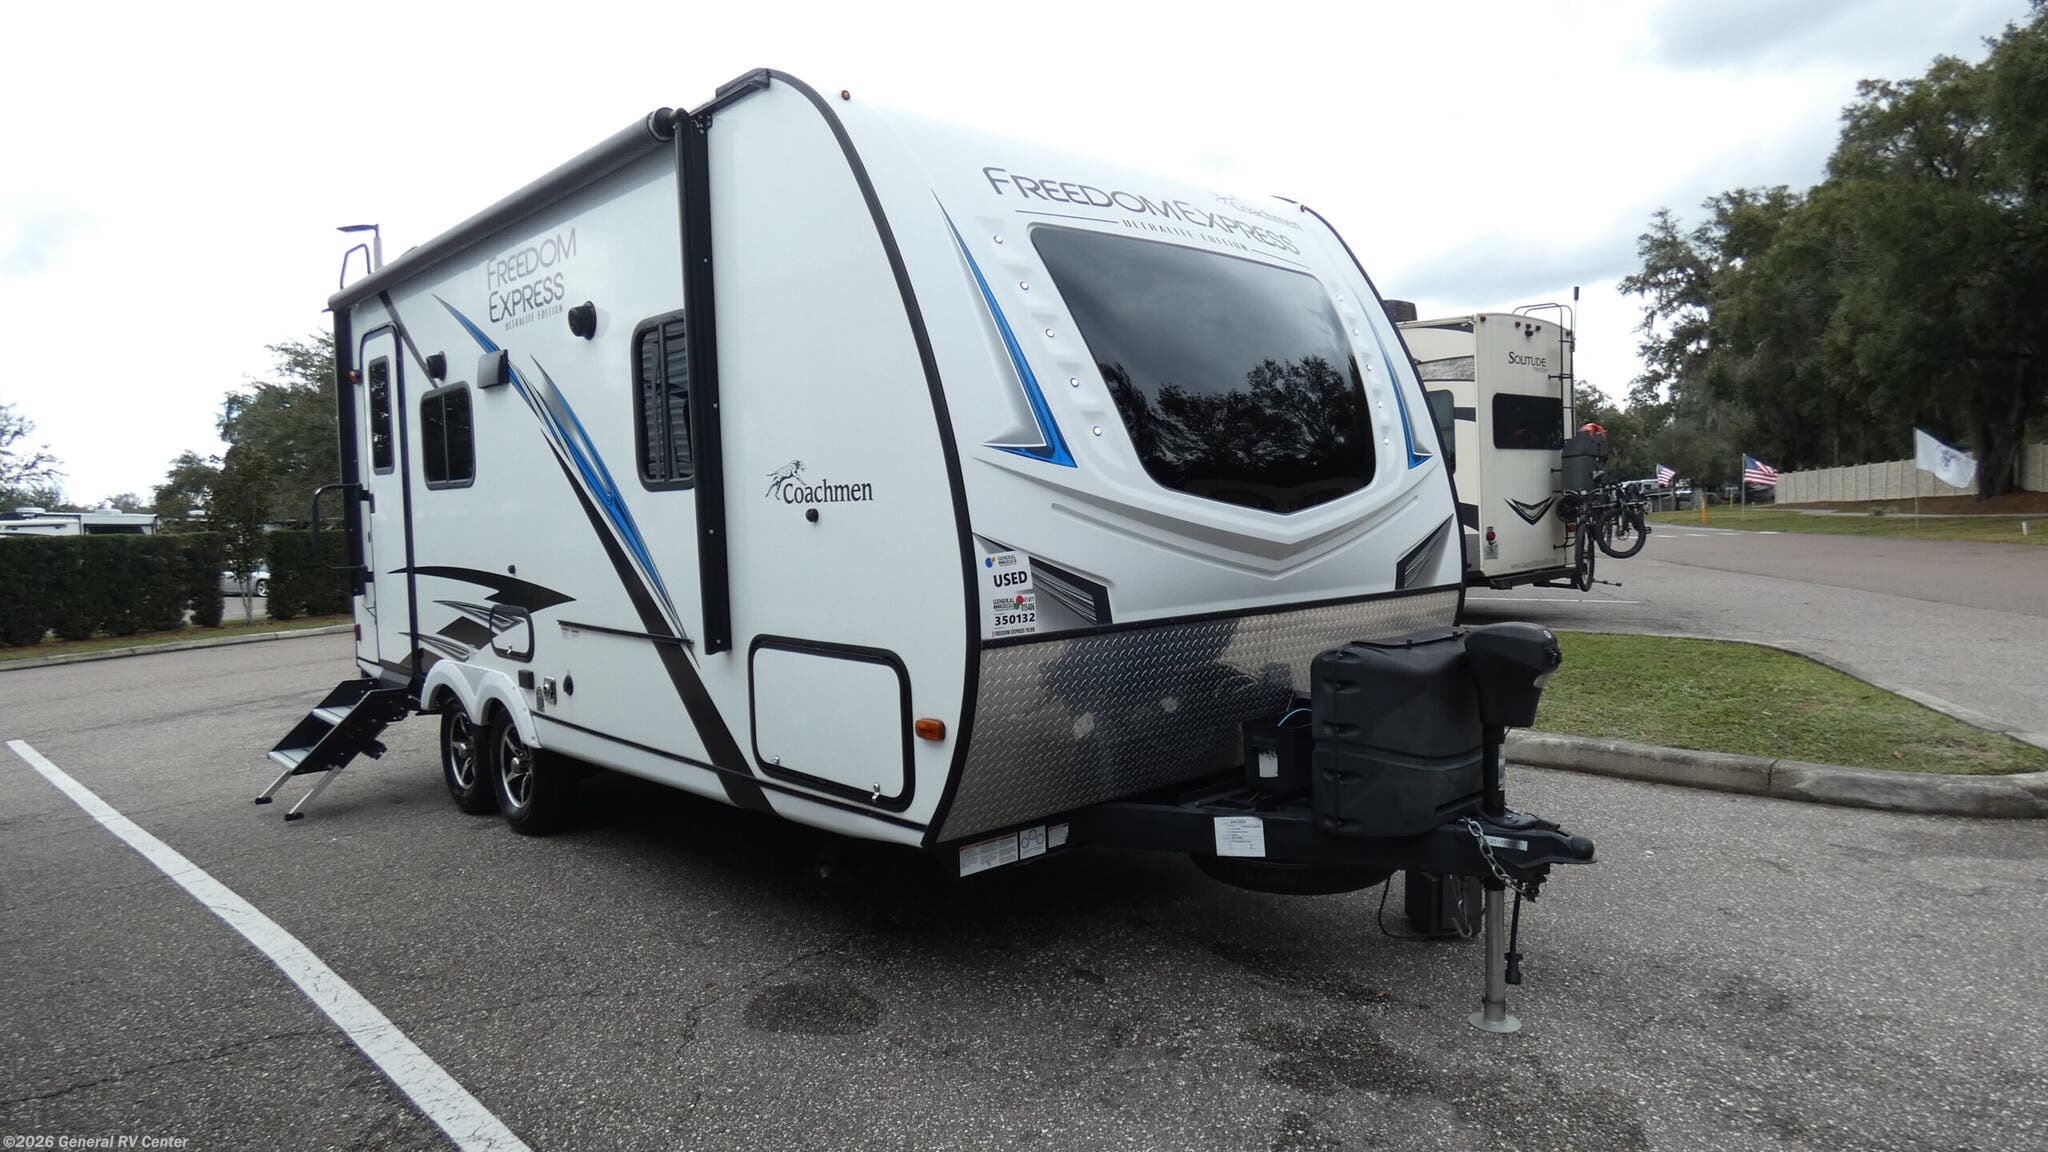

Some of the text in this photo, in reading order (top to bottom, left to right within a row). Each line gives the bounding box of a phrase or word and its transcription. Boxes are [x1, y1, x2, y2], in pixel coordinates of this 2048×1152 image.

[487, 228, 576, 290] FREEDOM
[489, 272, 564, 323] EXPRESS
[1508, 351, 1547, 367] SOLITUDE
[783, 479, 873, 504] Coachmen
[993, 571, 1028, 588] USED
[994, 613, 1036, 626] 350132
